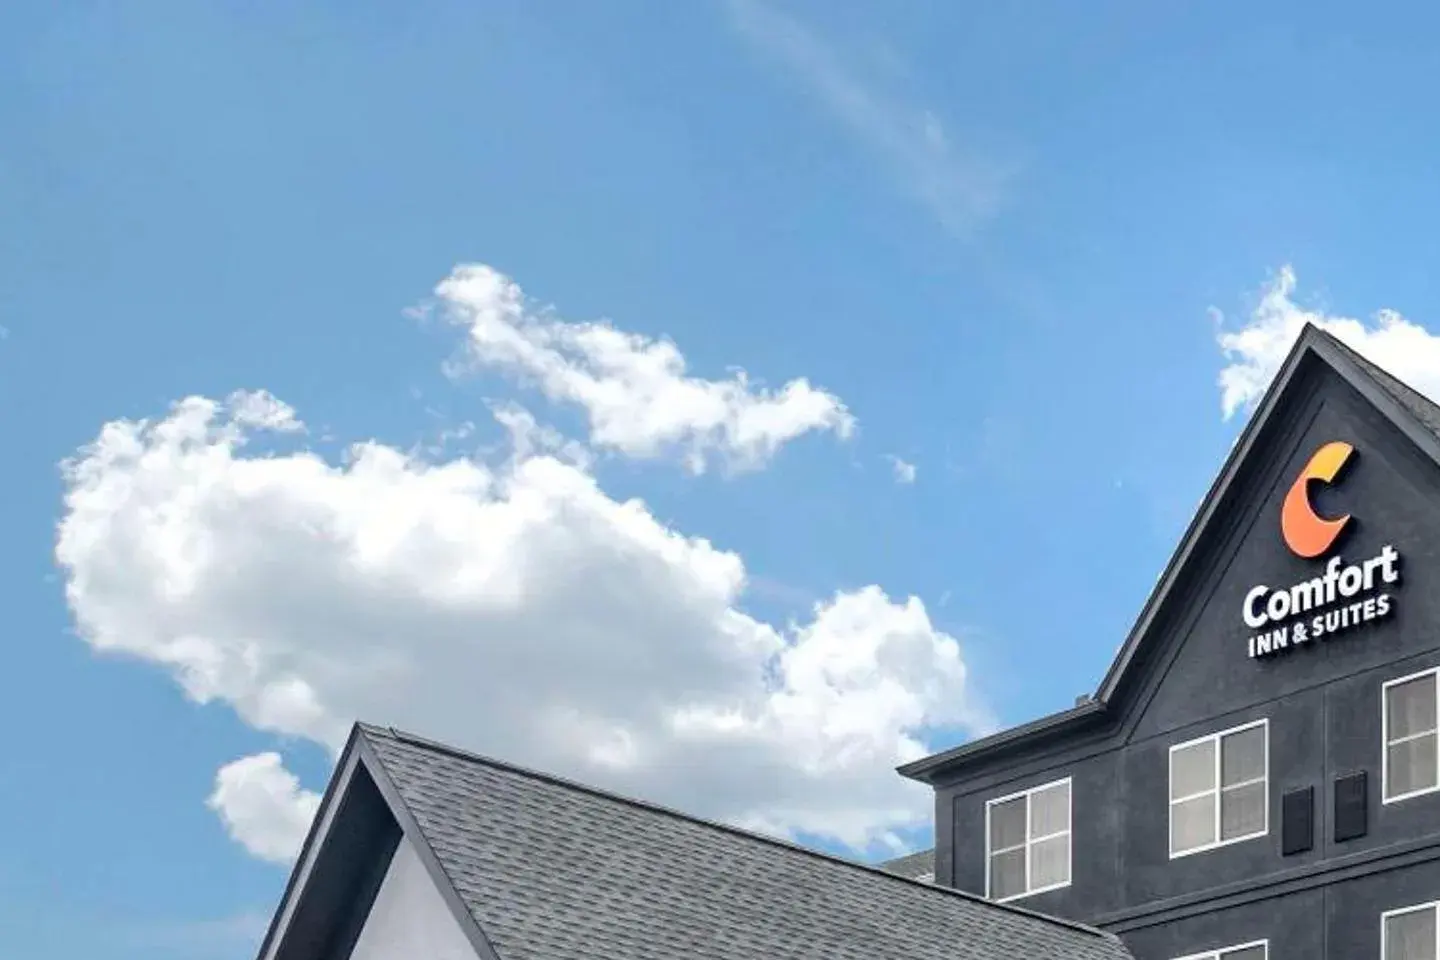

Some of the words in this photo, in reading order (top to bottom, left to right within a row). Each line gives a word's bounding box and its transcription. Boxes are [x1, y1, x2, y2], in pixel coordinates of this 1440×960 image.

[1242, 545, 1399, 628] Comfort
[1248, 627, 1289, 658] INN
[1291, 622, 1309, 645] &
[1311, 595, 1391, 637] SUITES
